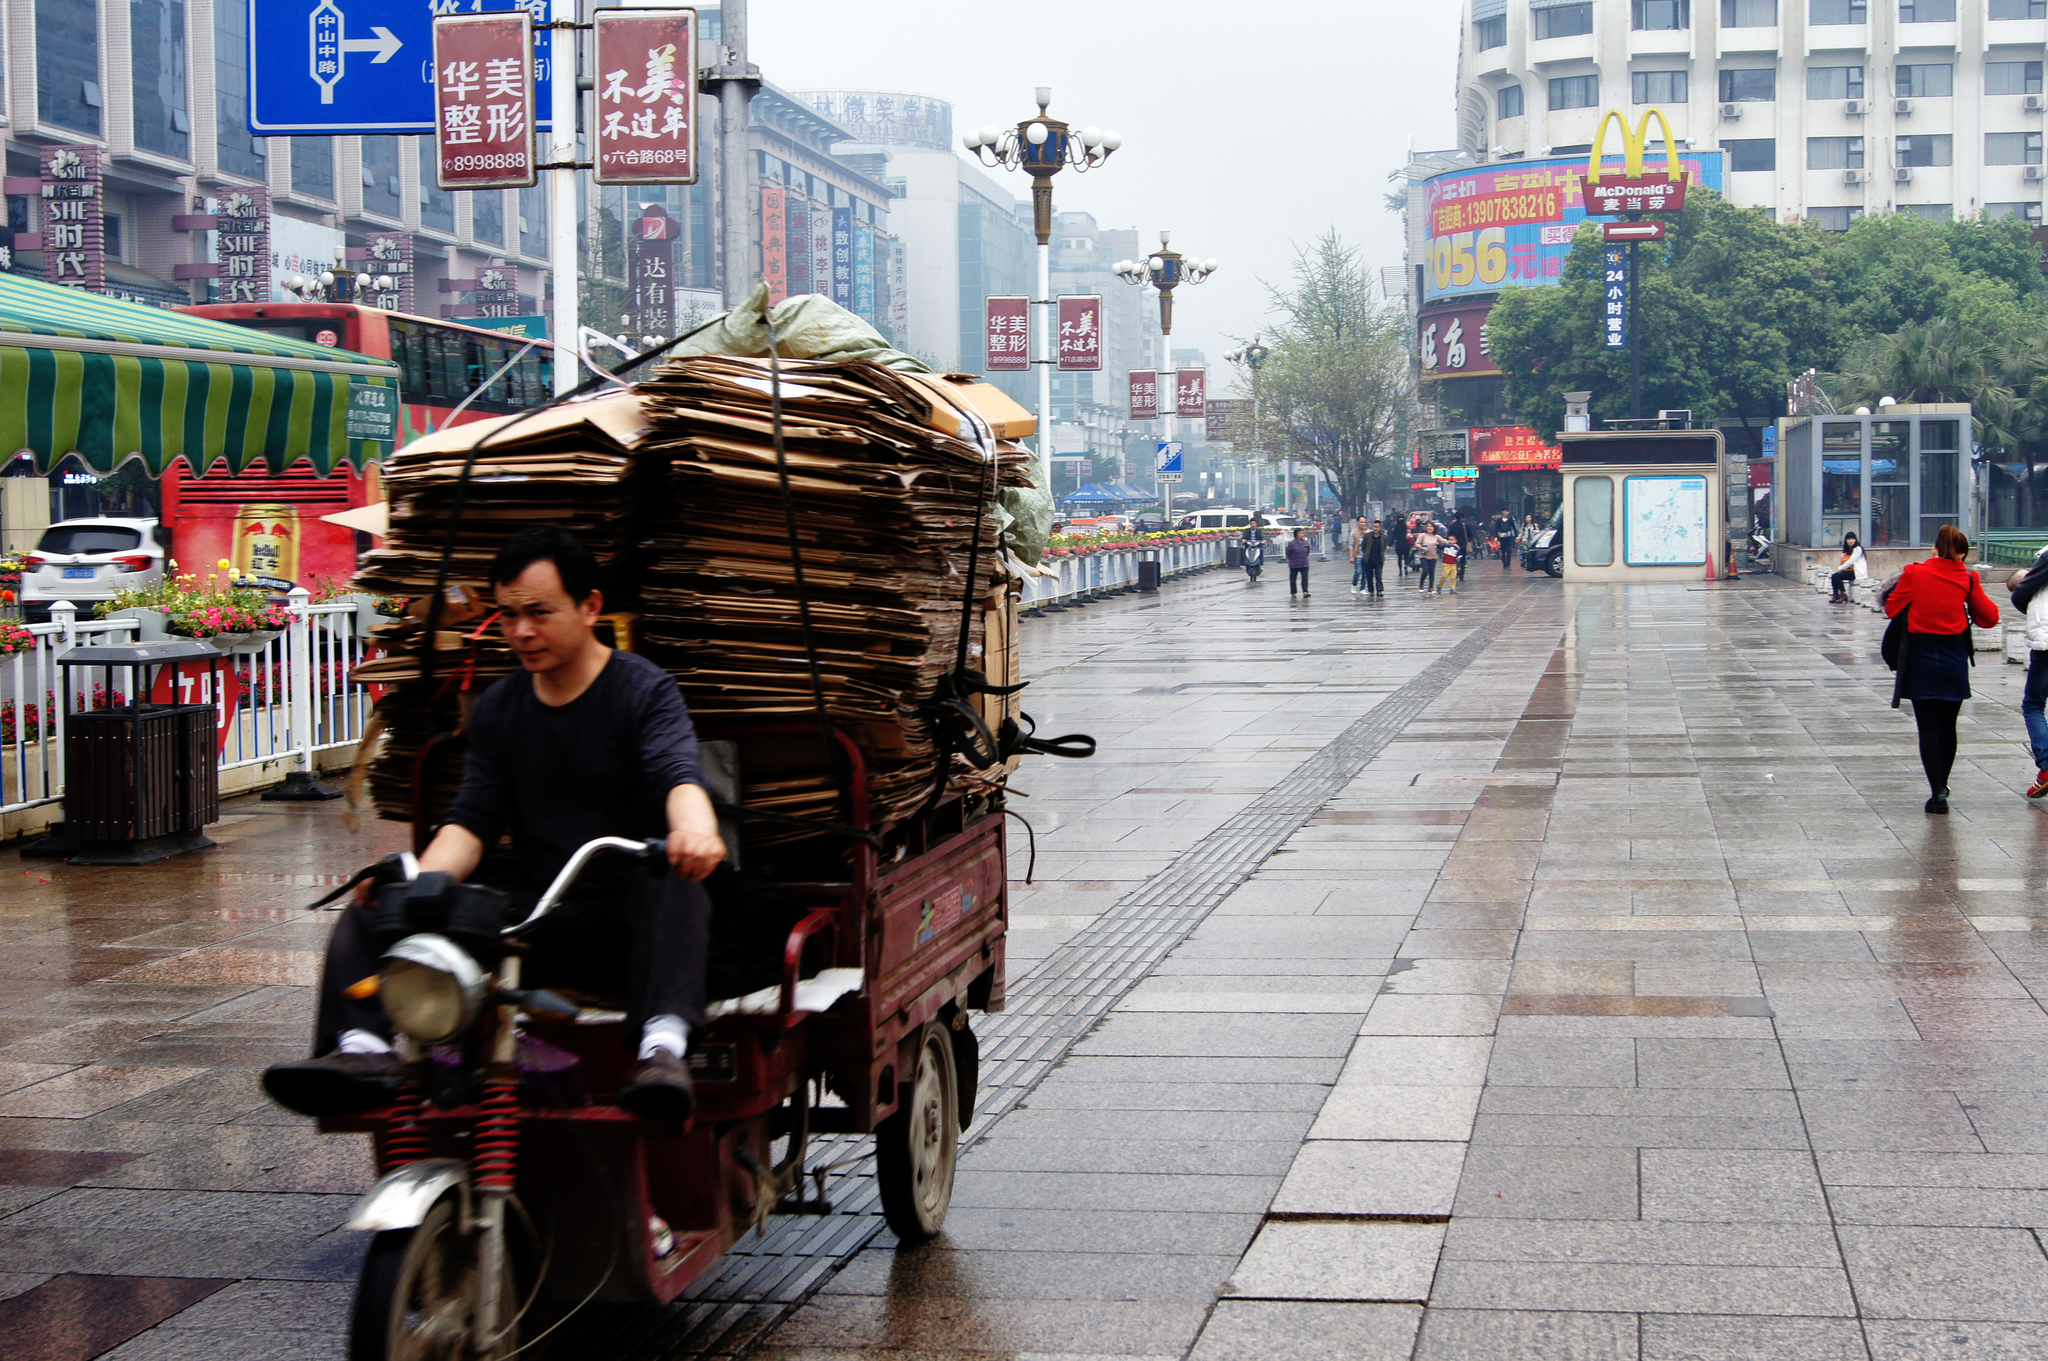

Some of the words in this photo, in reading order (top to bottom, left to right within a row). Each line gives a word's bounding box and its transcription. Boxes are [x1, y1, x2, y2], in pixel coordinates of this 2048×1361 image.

[318, 14, 337, 74] 中山中路
[442, 58, 524, 102] 华美
[601, 43, 686, 105] 不美
[444, 101, 526, 146] 整形
[601, 105, 688, 141] 不过年
[869, 124, 898, 137] XIAO
[454, 153, 526, 172] 8998888
[610, 149, 688, 165] 六合路68号
[67, 165, 88, 179] SHE
[1593, 184, 1675, 198] McDonald's
[49, 201, 88, 221] SHE
[240, 205, 259, 218] SHE
[1602, 196, 1666, 212] 麦当劳
[224, 235, 259, 253] SHE
[835, 230, 850, 298] 数创教育
[229, 255, 256, 302] 时代
[482, 305, 511, 319] SHE
[1606, 270, 1625, 346] 24小时营业
[989, 315, 1027, 334] 华美
[1060, 310, 1098, 338] 不美
[989, 333, 1027, 353] 整形
[1060, 337, 1099, 353] 不过年
[1130, 382, 1156, 396] 华美
[1178, 378, 1203, 397] 不美
[1130, 395, 1157, 408] 整形
[1177, 396, 1204, 407] 不过年
